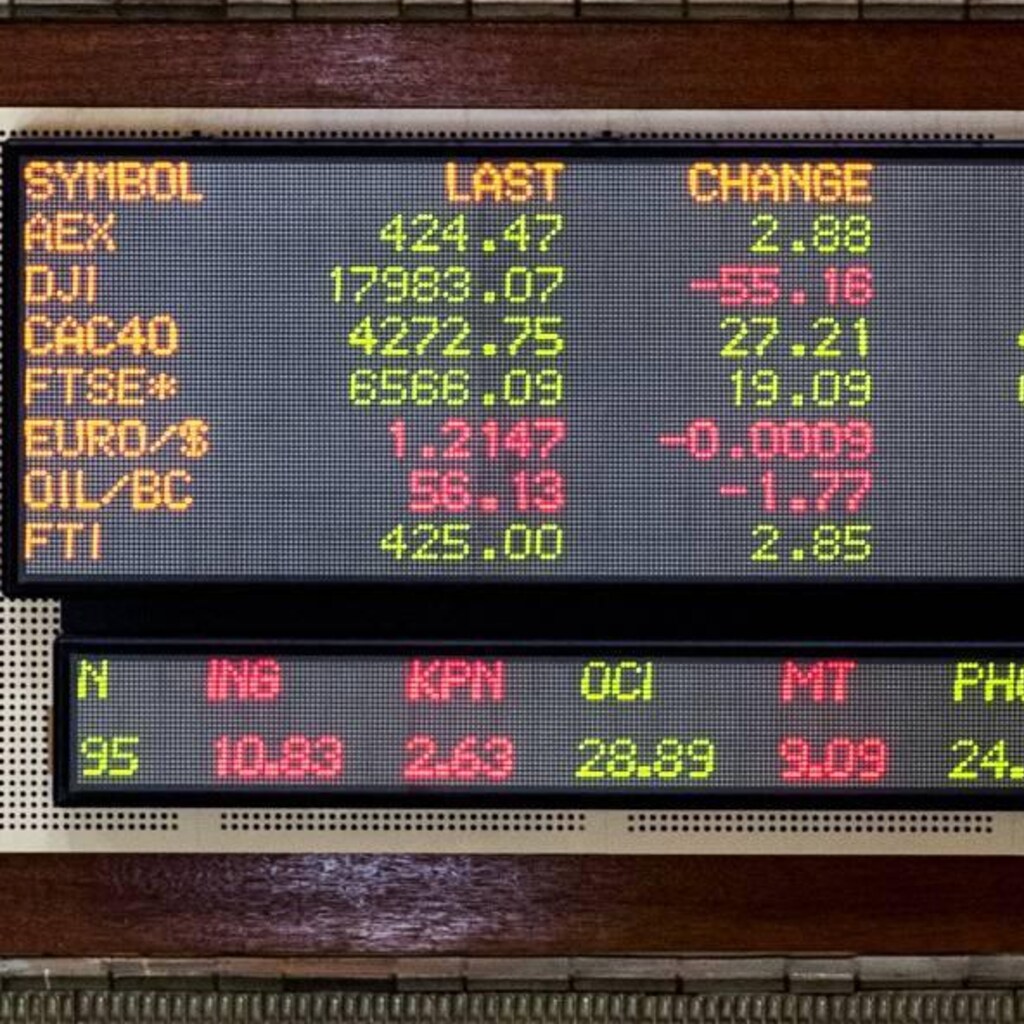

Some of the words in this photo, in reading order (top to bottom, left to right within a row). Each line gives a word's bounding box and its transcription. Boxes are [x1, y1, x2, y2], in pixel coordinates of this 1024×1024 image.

[24, 162, 203, 202] SYMBOL
[445, 163, 565, 202] LAST
[688, 163, 872, 203] CHANGE
[25, 212, 116, 253] AEX
[385, 215, 558, 251] 424.47
[751, 219, 870, 253] 2.88
[25, 264, 96, 304] DJI
[333, 266, 564, 302] 17983.07
[694, 265, 873, 305] -55.16
[25, 314, 178, 357] CAC40
[349, 317, 564, 358] 4272.75
[720, 317, 868, 358] 27.21
[349, 369, 562, 405] 6566.09
[730, 370, 872, 406] 19.09
[24, 417, 205, 458] EURO/$
[394, 418, 566, 459] 1.2147
[664, 419, 874, 461] -0.0009
[24, 469, 191, 511] OIL/BC
[411, 469, 564, 513] 56.13
[724, 469, 872, 512] -1.77
[25, 522, 102, 559] FTI
[384, 525, 562, 559] 425.00
[755, 526, 870, 560] 2.85
[78, 662, 107, 698] N
[206, 660, 282, 702] ING
[405, 660, 504, 703] KPN
[581, 662, 652, 701] OCI
[780, 662, 855, 703] MT
[84, 737, 138, 776] 95
[215, 735, 343, 780] 10.83
[404, 735, 514, 780] 2.63
[577, 739, 714, 779] 28.89
[779, 737, 889, 782] 9.09
